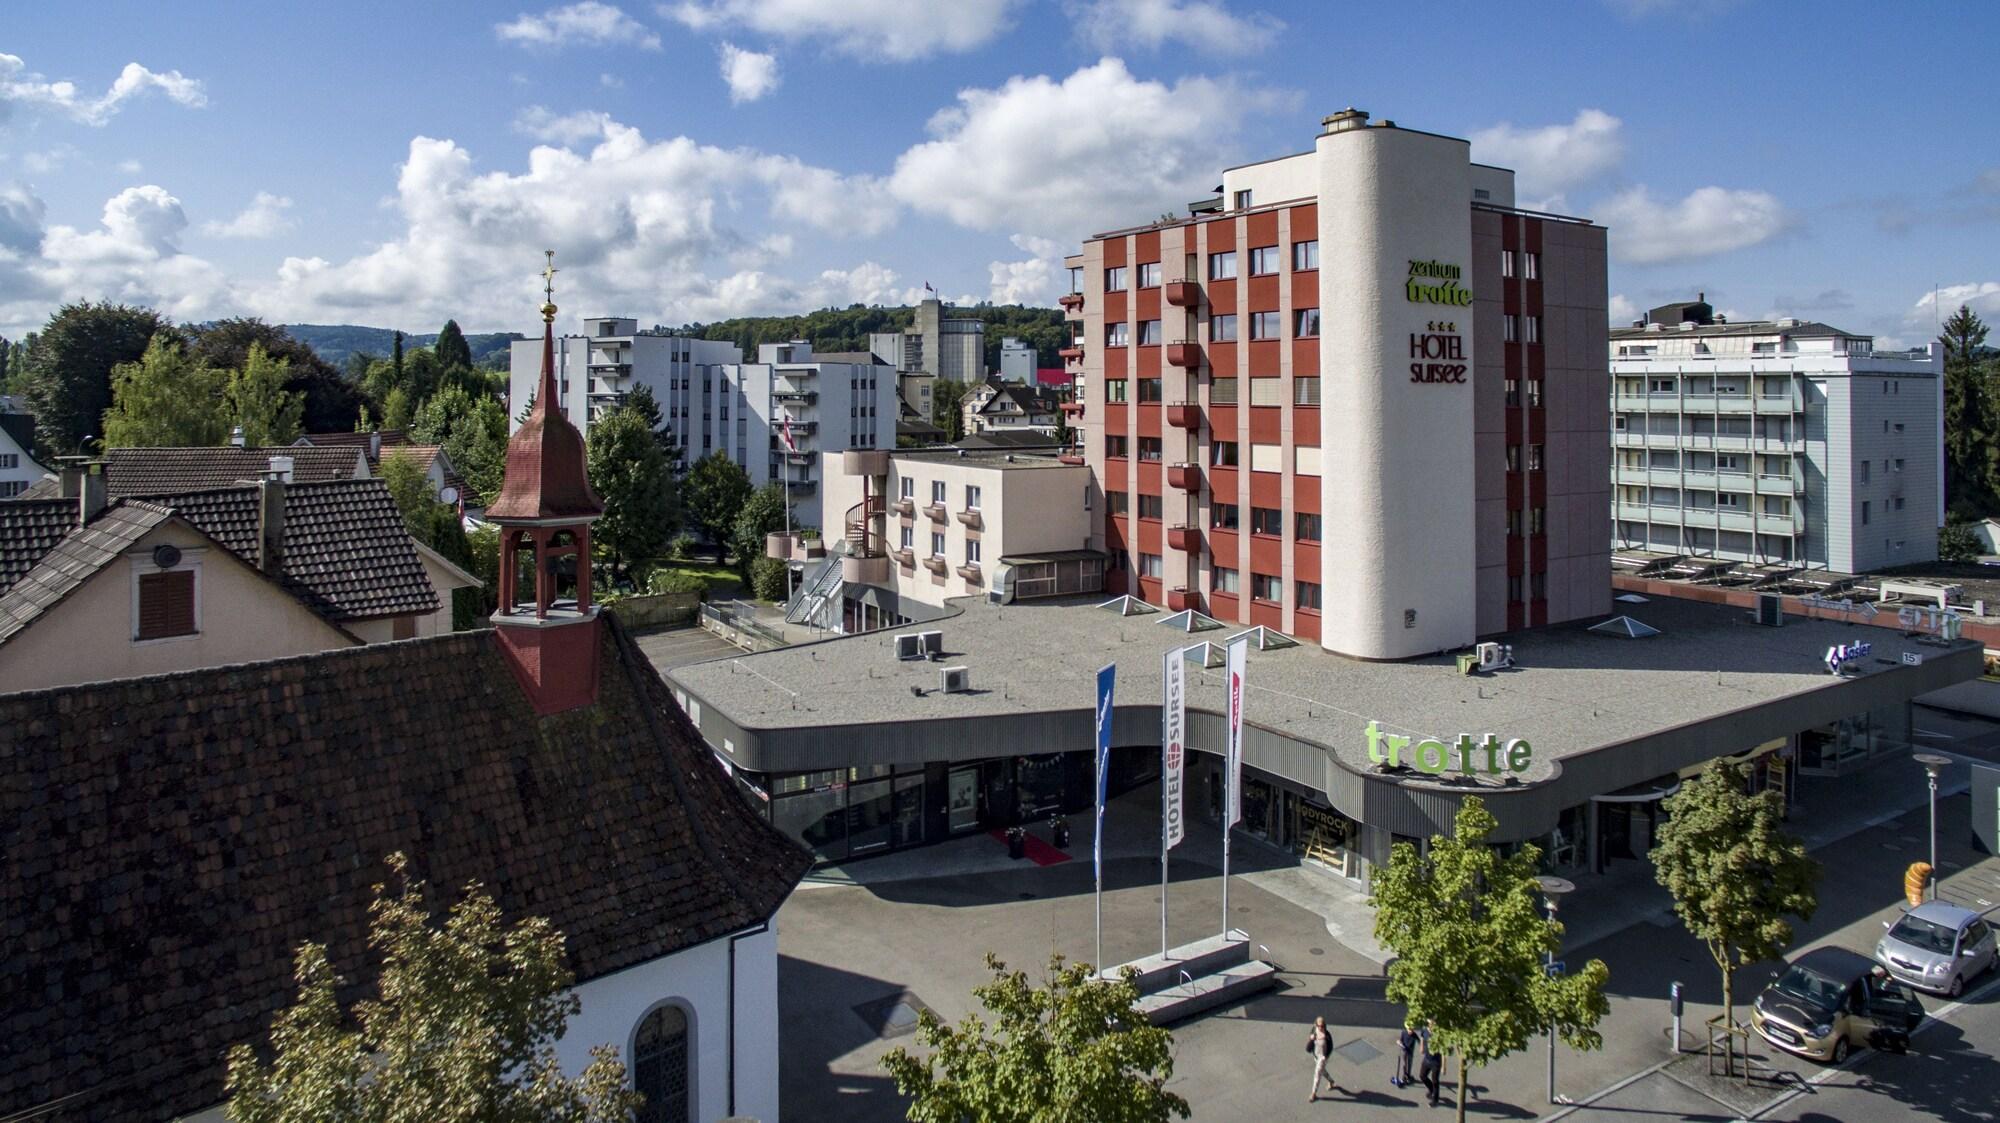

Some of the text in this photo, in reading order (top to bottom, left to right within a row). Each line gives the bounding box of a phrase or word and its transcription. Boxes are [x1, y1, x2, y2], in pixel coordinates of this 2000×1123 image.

[1410, 333, 1468, 360] HOTEL
[1904, 653, 1916, 663] 15
[1168, 658, 1181, 840] HOTEL SURSEE
[1364, 720, 1532, 775] trotte
